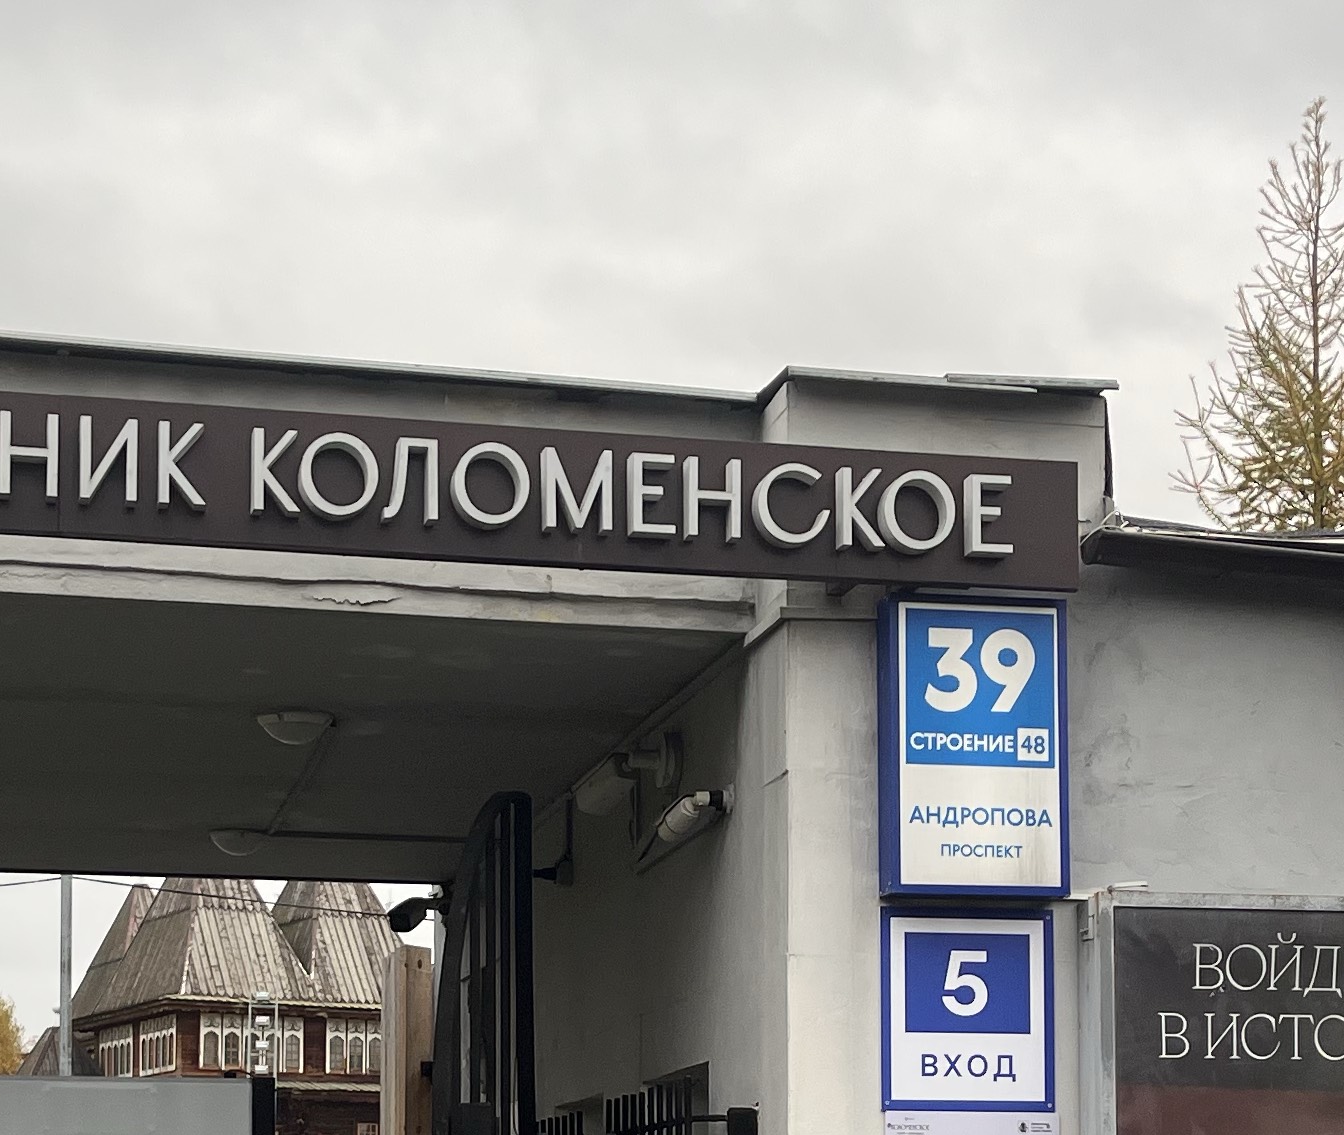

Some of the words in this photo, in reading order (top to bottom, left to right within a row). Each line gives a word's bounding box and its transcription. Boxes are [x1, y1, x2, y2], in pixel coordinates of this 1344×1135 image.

[249, 426, 1014, 558] КОЛОМЕНСКОЕ
[924, 626, 1036, 713] 39
[909, 731, 1015, 753] СТРОЕНИЕ
[1020, 735, 1046, 755] 48
[908, 805, 1053, 828] АНДРОПОВА
[940, 843, 1023, 859] ПРОСПЕКТ
[941, 949, 989, 1017] 5
[1157, 1011, 1191, 1060] В
[920, 1053, 1017, 1083] ВХОД
